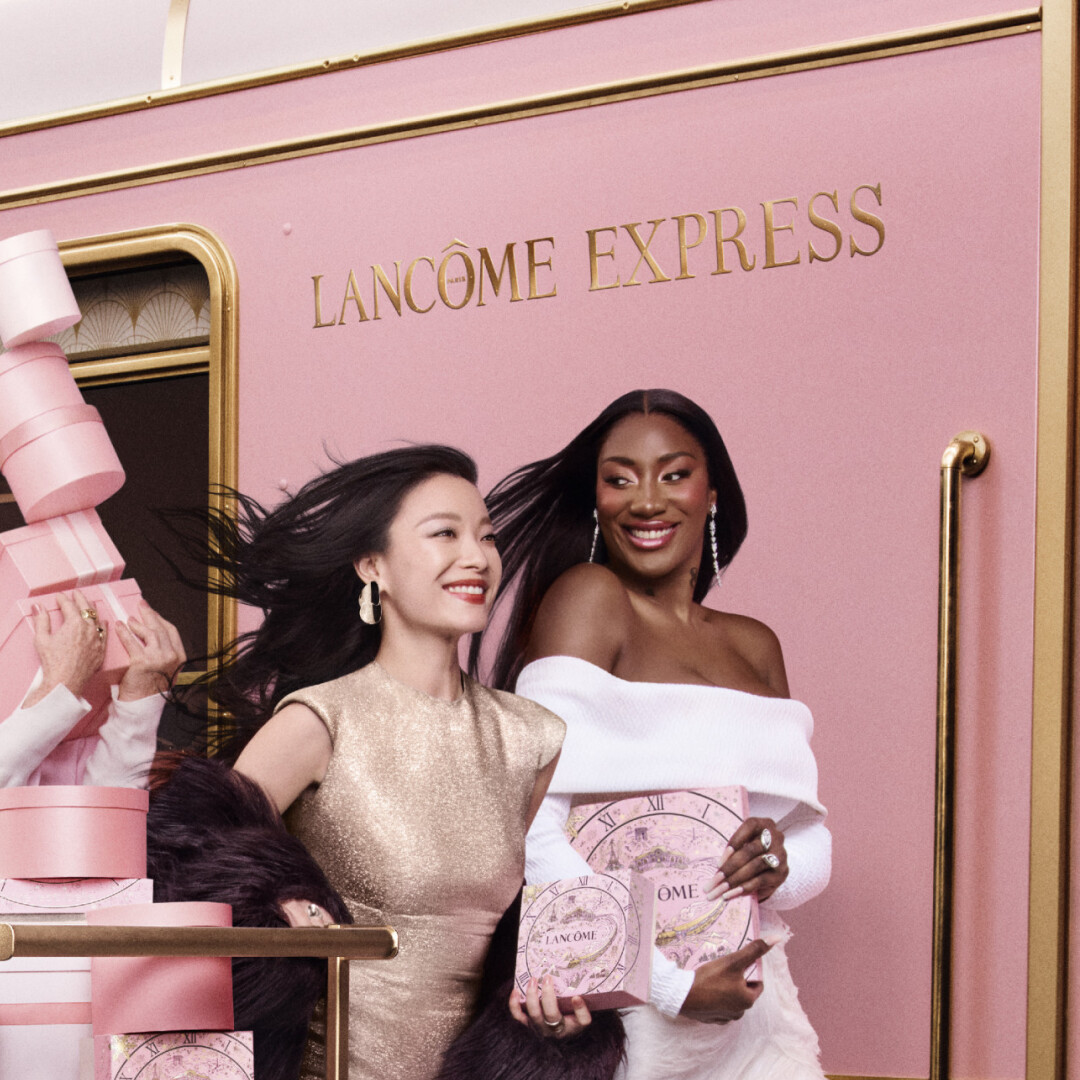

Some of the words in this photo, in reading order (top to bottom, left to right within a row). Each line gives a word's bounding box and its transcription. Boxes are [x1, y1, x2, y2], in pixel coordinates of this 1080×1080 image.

[311, 237, 557, 329] LANCÔME
[585, 182, 886, 291] EXPRESS
[647, 795, 665, 812] XII
[597, 811, 617, 832] XI
[657, 883, 700, 902] ÔME
[544, 930, 599, 945] LANCÔME
[145, 1042, 160, 1057] XI
